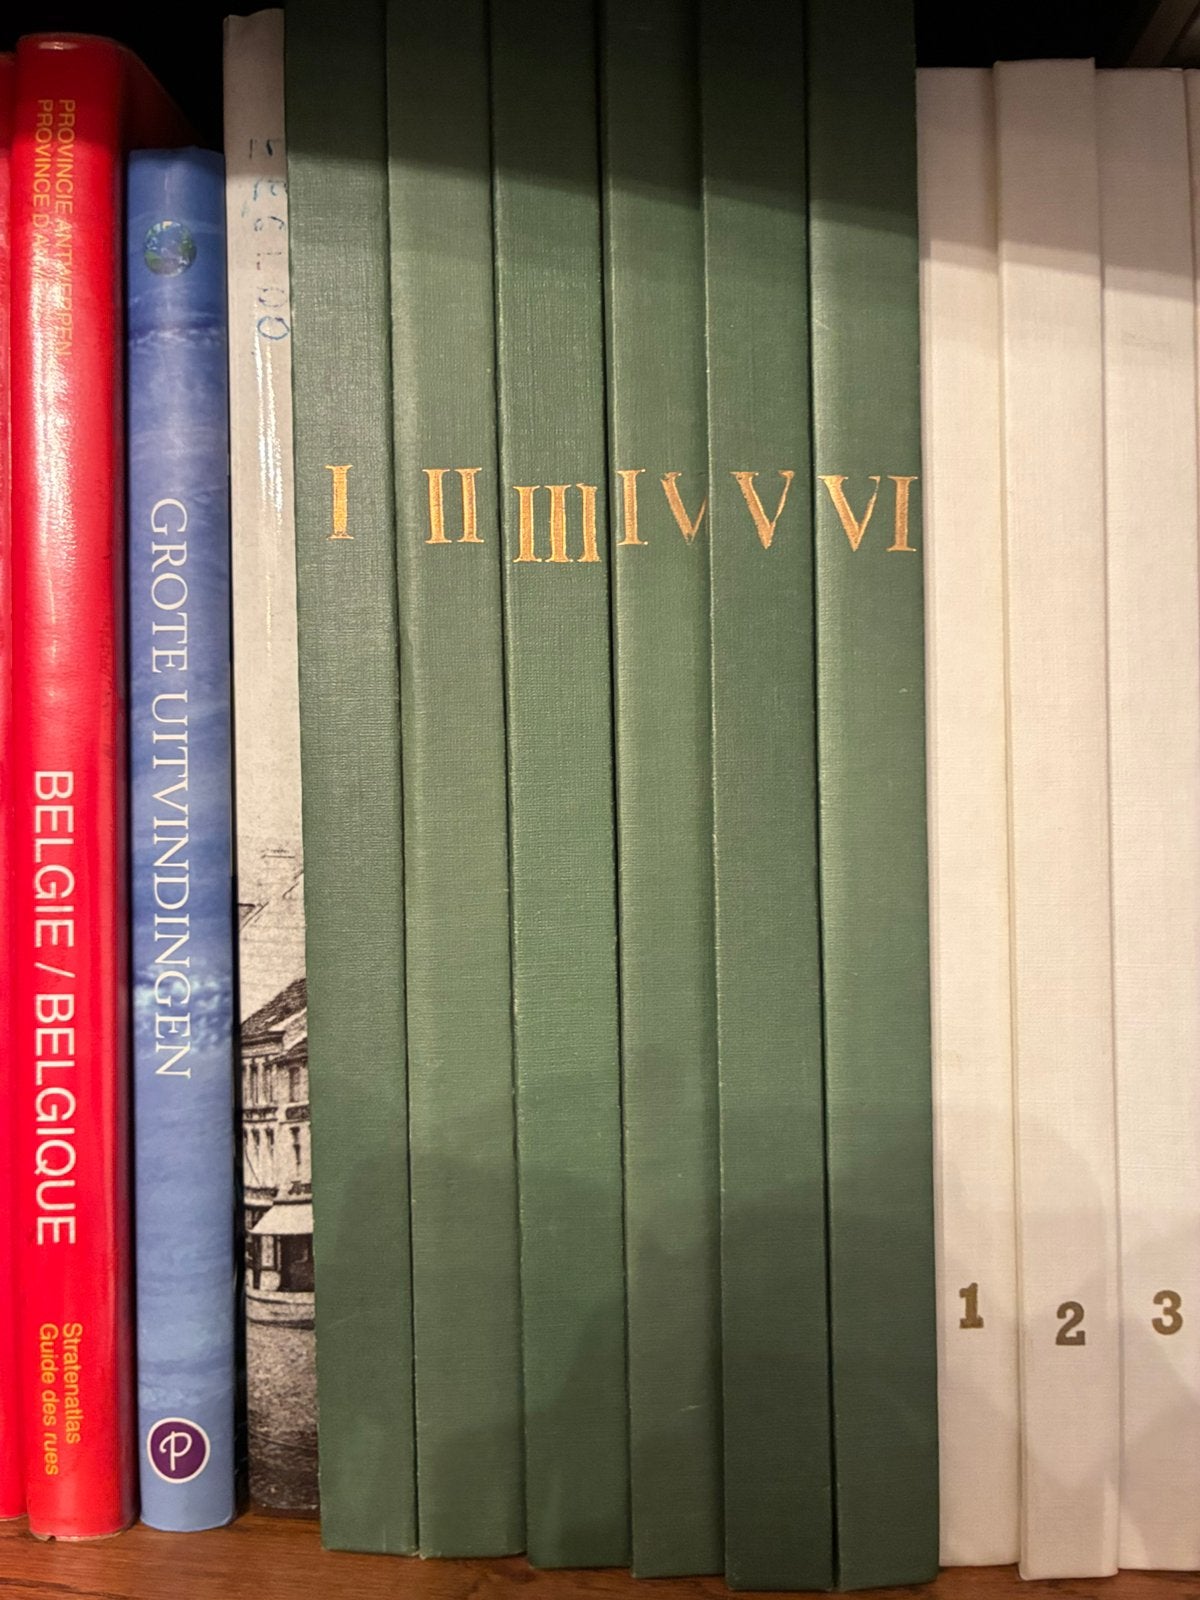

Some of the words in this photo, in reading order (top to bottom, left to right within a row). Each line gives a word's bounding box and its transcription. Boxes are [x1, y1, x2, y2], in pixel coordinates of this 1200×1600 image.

[33, 99, 53, 207] PROVINCE
[54, 99, 76, 214] PROVINCIE
[325, 464, 354, 541] I
[422, 467, 485, 544] II
[512, 483, 602, 562] III
[616, 468, 709, 545] IV
[730, 470, 795, 550] V
[818, 475, 918, 551] VI
[150, 498, 188, 673] GROTE
[34, 770, 75, 948] BELGIE
[151, 690, 191, 1079] UITVINDINGEN
[34, 993, 76, 1245] BELGIQUE
[959, 1282, 984, 1329] 1
[1055, 1301, 1086, 1345] 2
[1151, 1289, 1183, 1335] 3
[39, 1323, 59, 1384] Guide
[62, 1322, 84, 1445] Stratenatlas
[41, 1389, 60, 1427] des
[43, 1432, 59, 1476] rues
